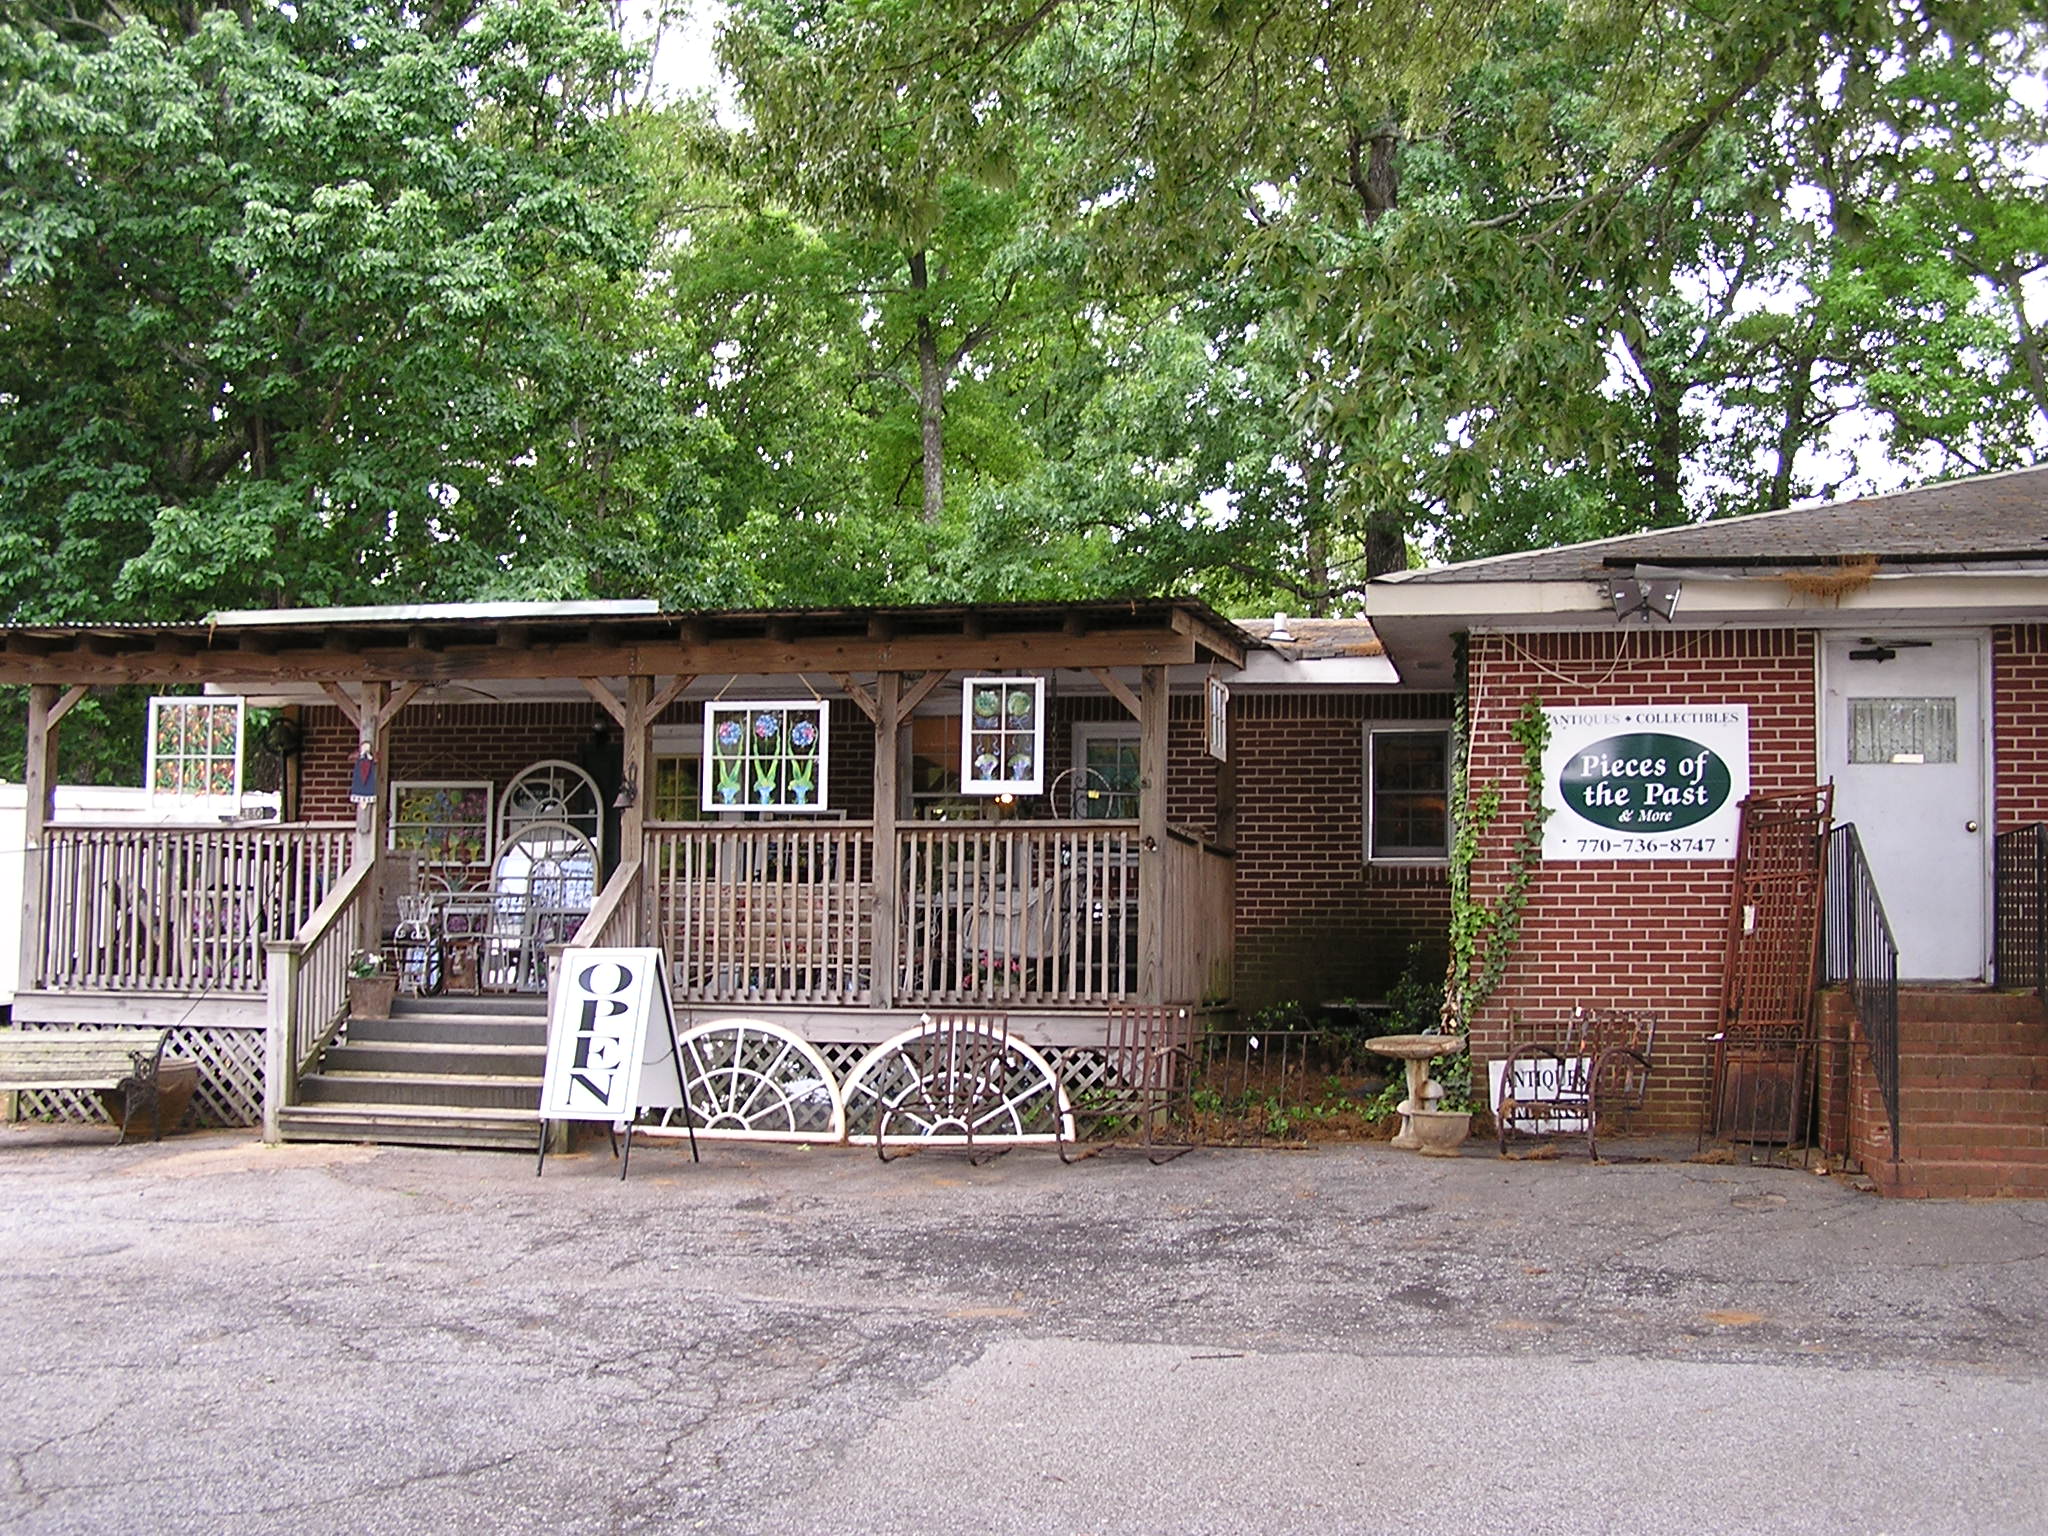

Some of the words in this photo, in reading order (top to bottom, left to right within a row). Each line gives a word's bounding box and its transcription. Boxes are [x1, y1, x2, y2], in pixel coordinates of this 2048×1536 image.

[1552, 714, 1621, 727] ANTIQUES
[1635, 712, 1740, 725] COLLECTIBLES
[1580, 753, 1666, 777] Pieces
[1678, 750, 1710, 786] of
[1583, 780, 1630, 807] the
[1643, 782, 1709, 806] Past
[1618, 809, 1634, 823] &
[1637, 809, 1673, 822] More
[1577, 838, 1716, 853] 770-736-8747
[566, 963, 633, 1107] OPEN
